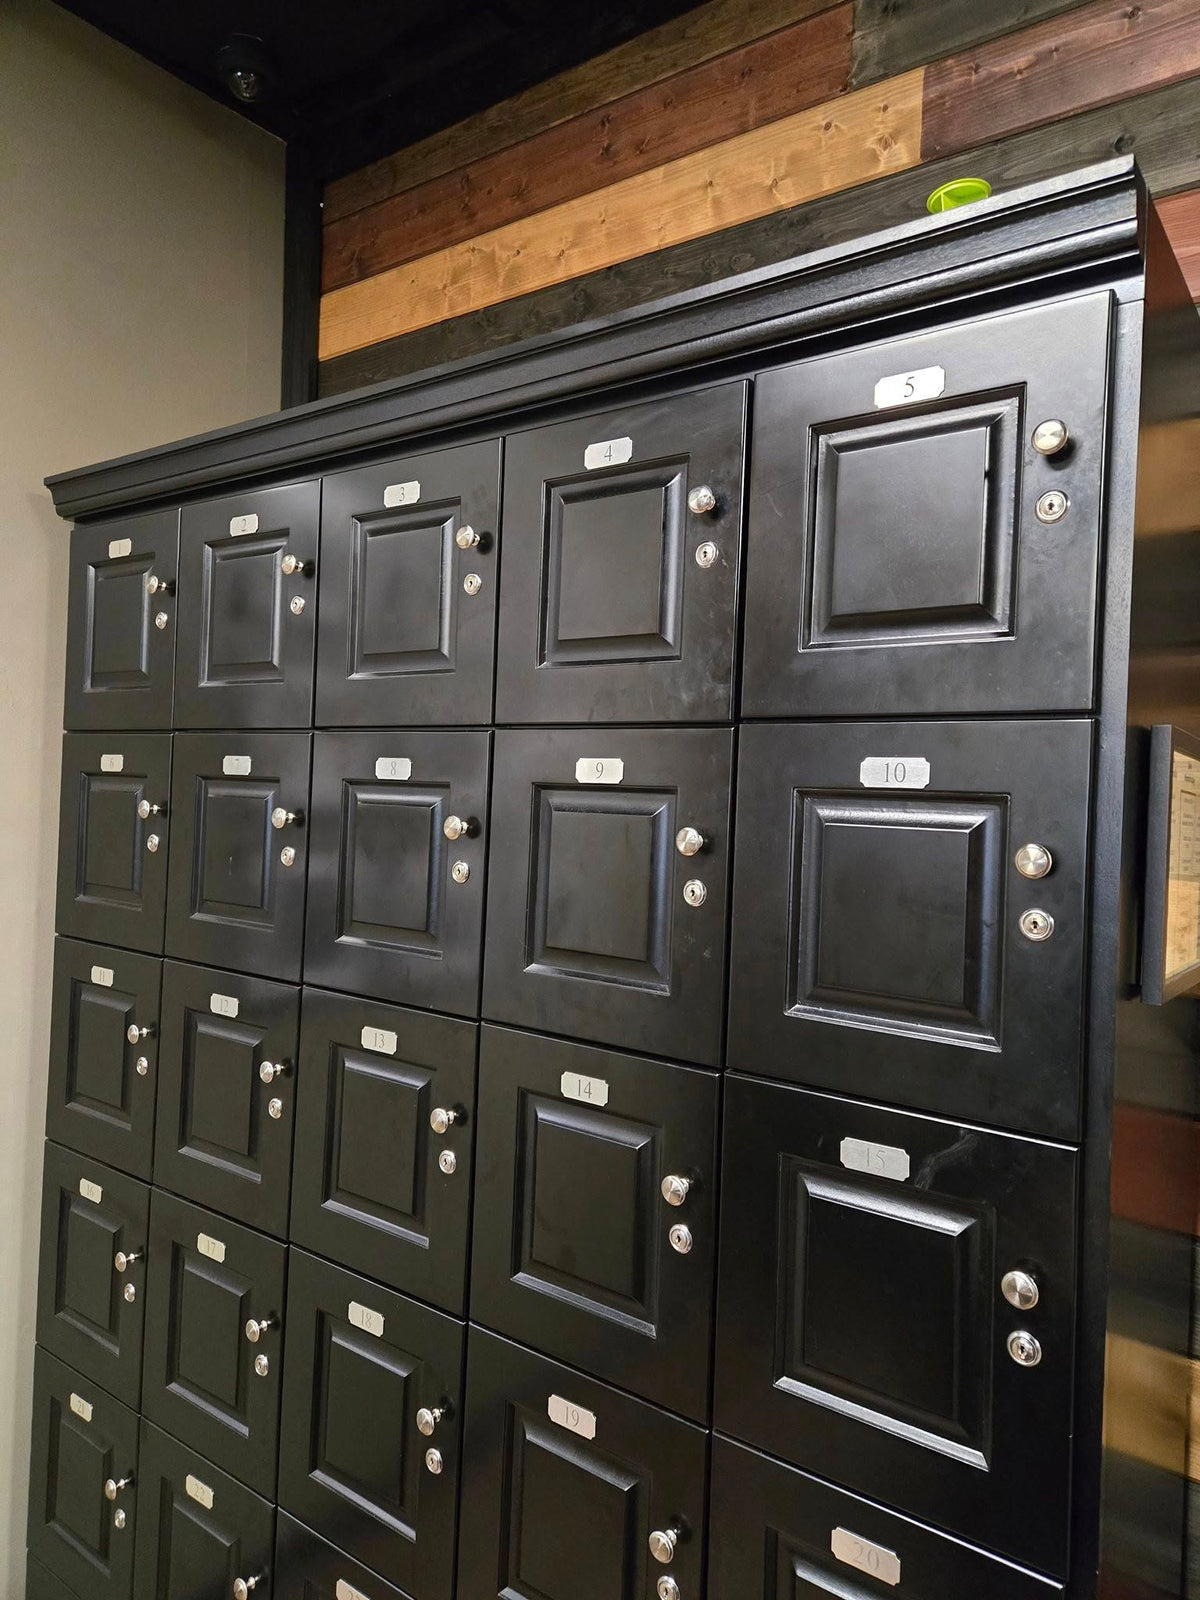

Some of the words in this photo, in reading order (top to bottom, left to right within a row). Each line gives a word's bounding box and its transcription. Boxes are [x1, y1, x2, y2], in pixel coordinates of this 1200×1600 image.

[904, 376, 915, 399] 5
[604, 444, 612, 462] 4
[399, 487, 405, 502] 3
[241, 519, 246, 532] 2
[390, 761, 397, 775] 8
[596, 761, 604, 779] 9
[883, 762, 906, 783] 10
[220, 999, 229, 1013] 12
[374, 1032, 385, 1048] 13
[577, 1079, 592, 1099] 14
[866, 1147, 886, 1171] 15
[207, 1240, 216, 1255] 17
[361, 1310, 372, 1328] 18
[564, 1406, 579, 1428] 19
[854, 1542, 880, 1571] 20
